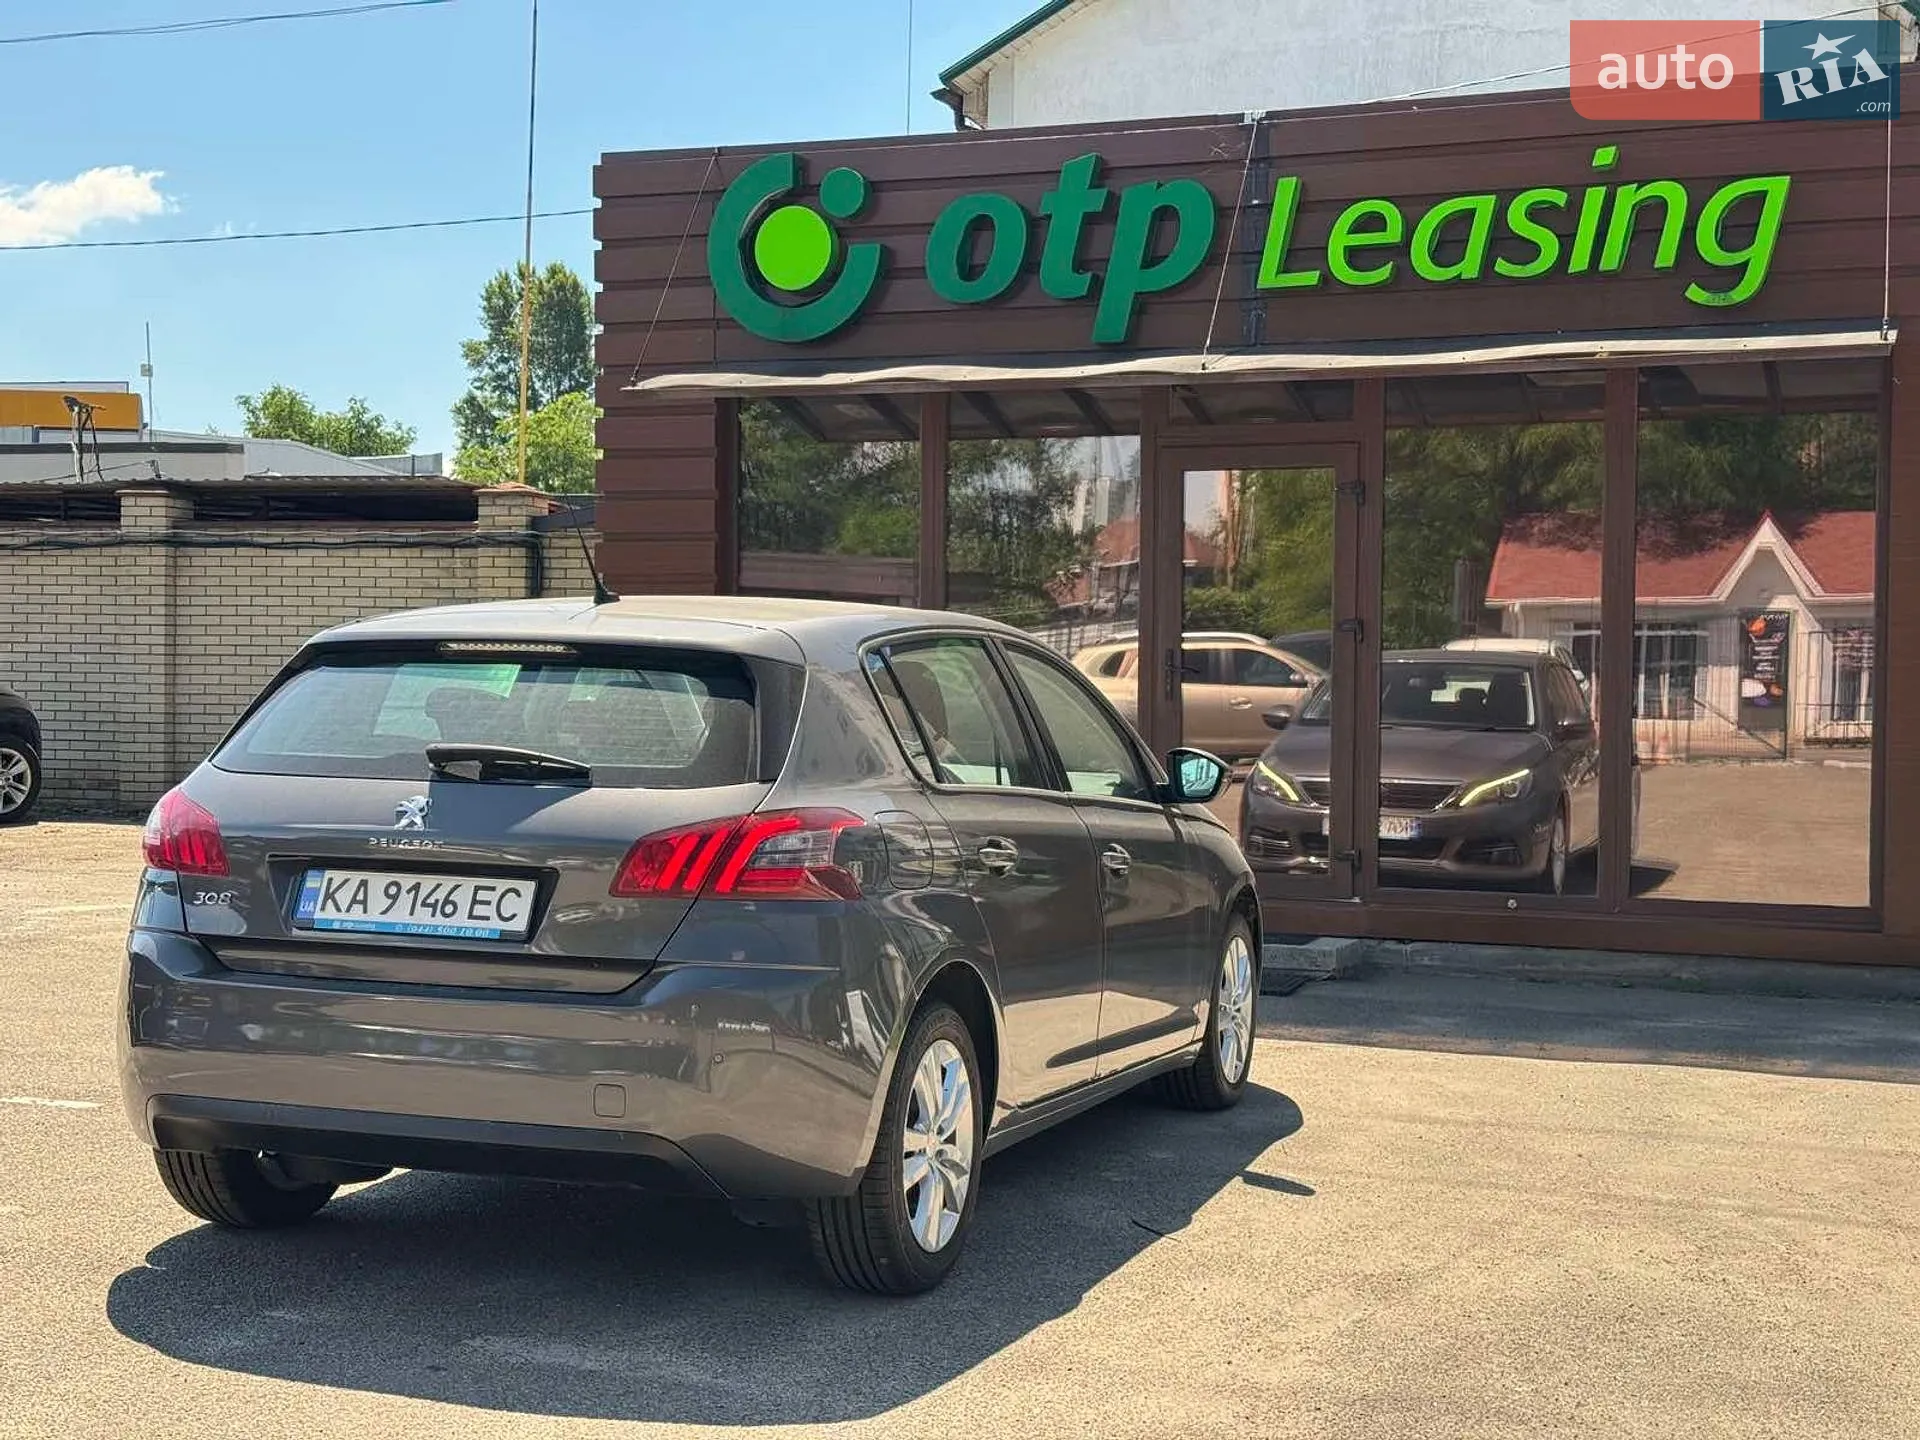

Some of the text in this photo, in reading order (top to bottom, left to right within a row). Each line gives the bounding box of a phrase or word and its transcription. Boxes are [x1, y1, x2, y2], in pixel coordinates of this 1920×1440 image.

[924, 145, 1793, 345] otp Leasing
[367, 837, 445, 850] PEUGEOT
[192, 891, 232, 905] 308
[319, 877, 522, 923] KA 9146 EC
[299, 900, 315, 913] UA
